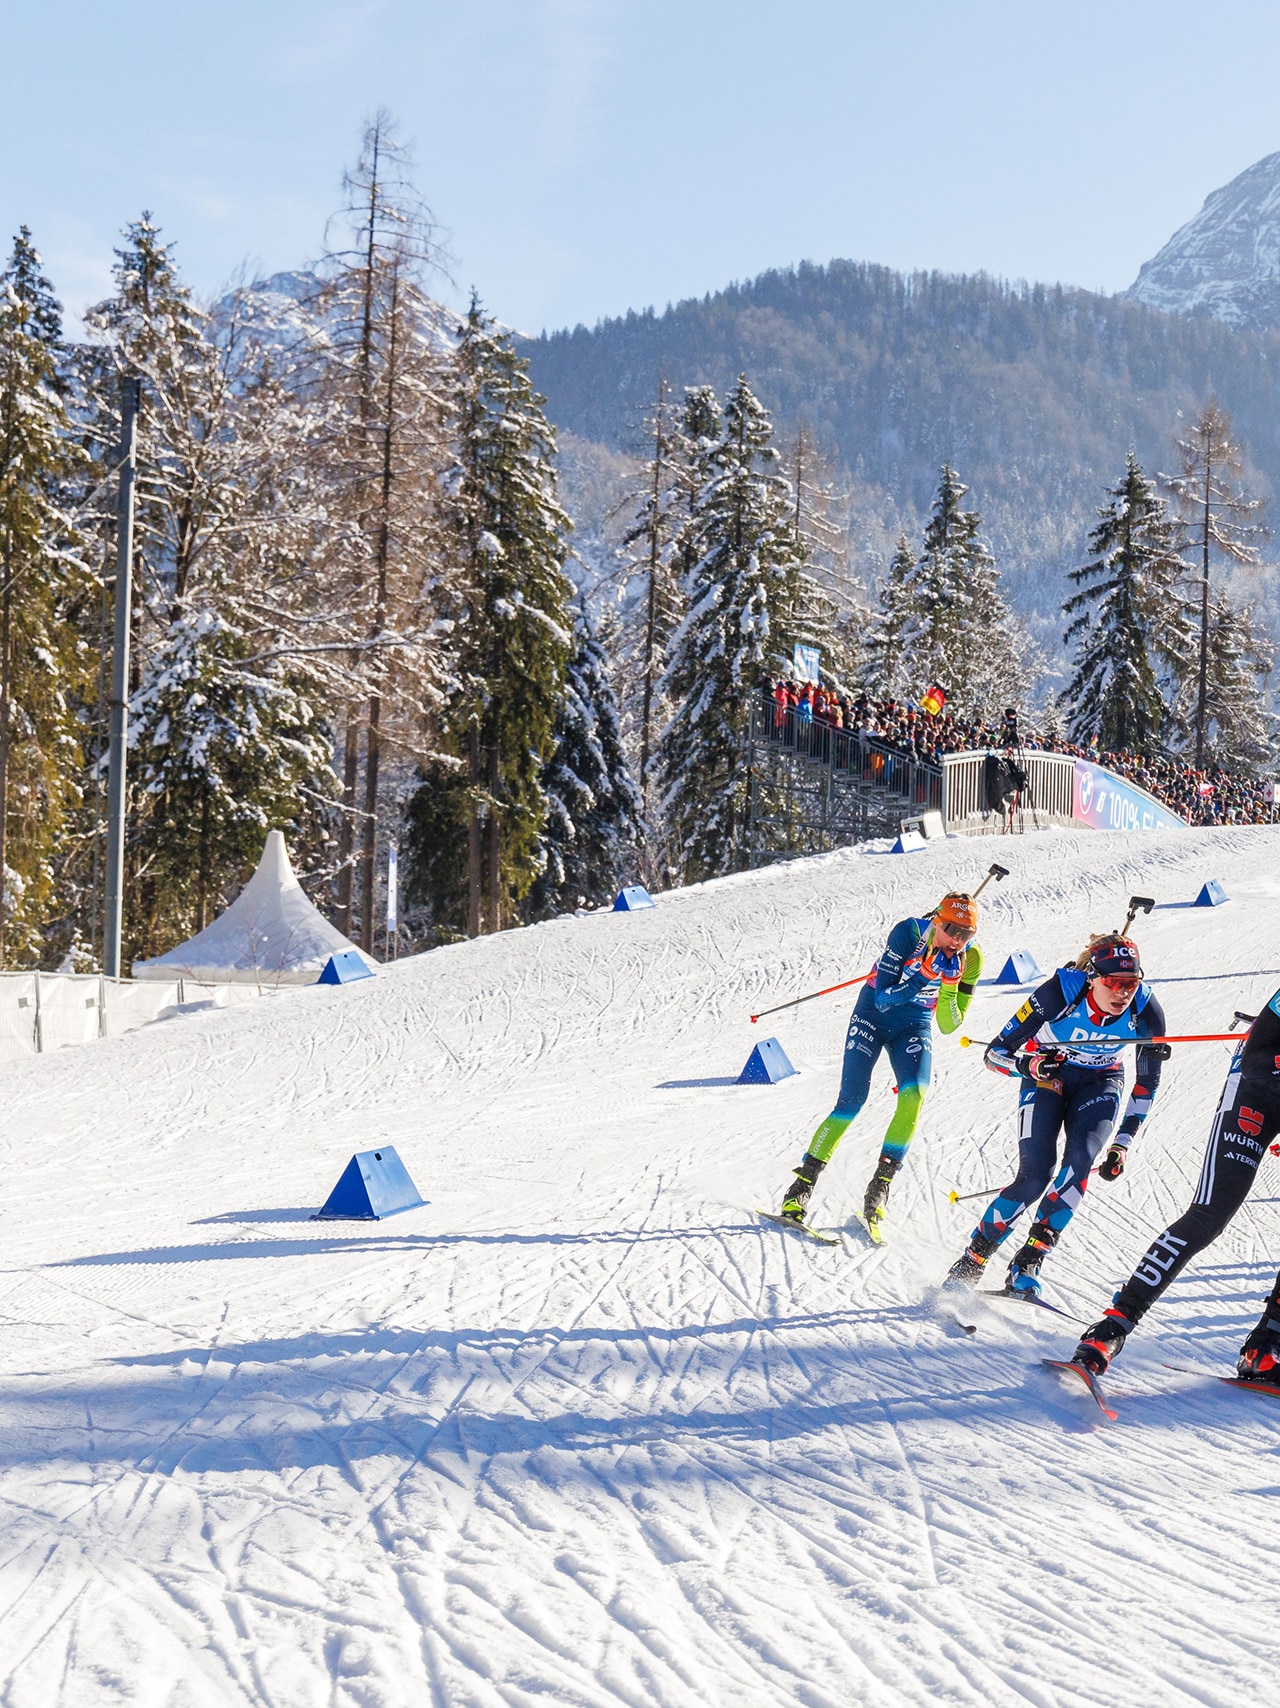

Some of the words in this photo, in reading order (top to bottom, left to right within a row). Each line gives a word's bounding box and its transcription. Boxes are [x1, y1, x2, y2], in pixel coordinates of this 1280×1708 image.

[1109, 791, 1140, 831] 100%
[1112, 945, 1136, 958] ice
[858, 1029, 875, 1043] NLB
[1077, 1095, 1117, 1112] CRAFT
[812, 1126, 830, 1157] LOVENIA
[1223, 1131, 1264, 1156] WÜRTH
[1132, 1229, 1188, 1287] GER
